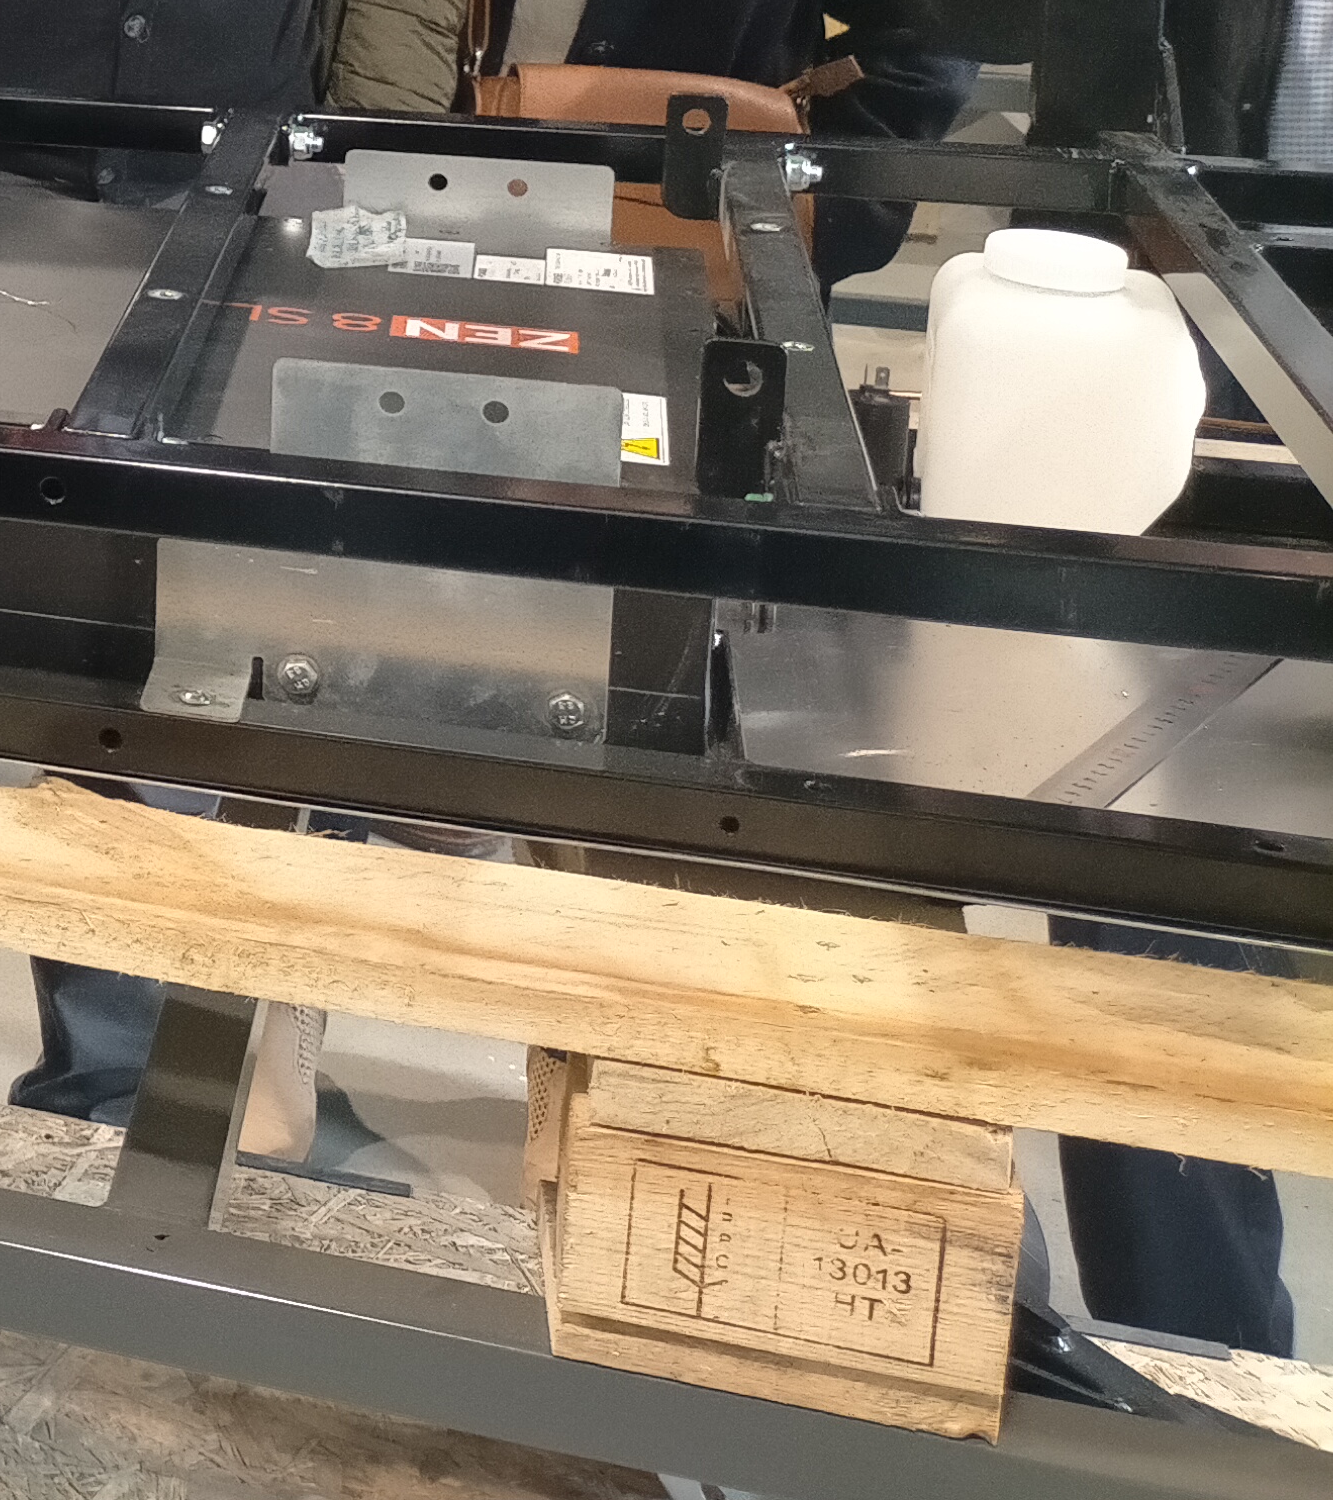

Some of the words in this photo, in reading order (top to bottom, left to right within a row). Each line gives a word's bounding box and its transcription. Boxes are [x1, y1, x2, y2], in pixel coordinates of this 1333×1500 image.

[331, 312, 382, 332] 8
[403, 317, 572, 352] ZEN
[813, 1256, 912, 1295] 13013
[834, 1292, 885, 1321] HT
